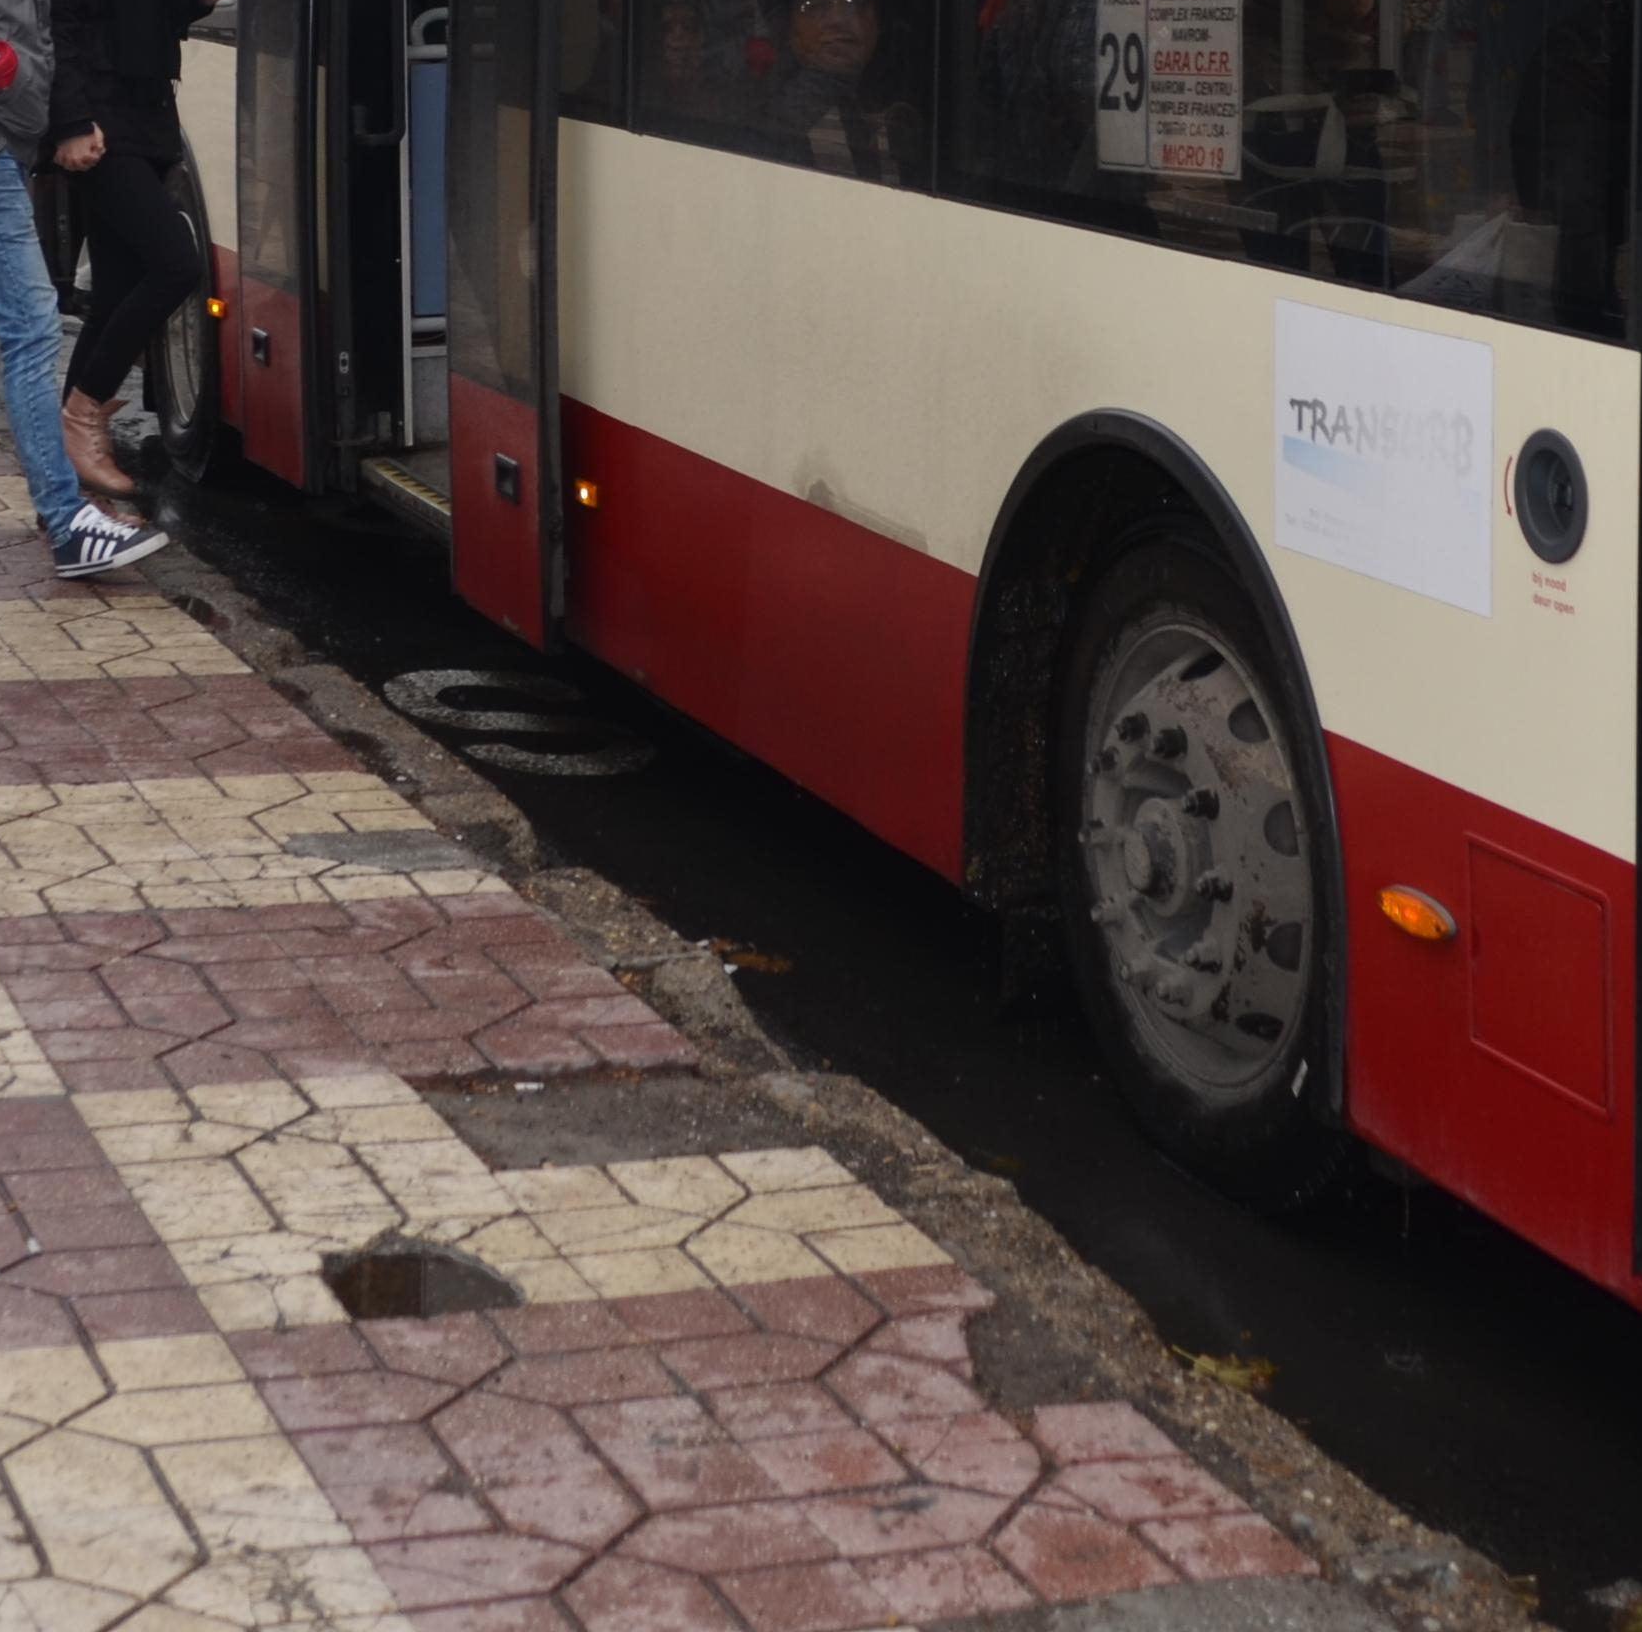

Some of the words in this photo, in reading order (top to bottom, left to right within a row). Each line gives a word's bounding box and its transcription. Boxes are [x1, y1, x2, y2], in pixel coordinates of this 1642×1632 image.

[1149, 7, 1190, 22] COMPLEX
[1154, 51, 1192, 72] GARA
[1194, 51, 1232, 73] C.F.R.
[1098, 32, 1145, 113] 29
[1194, 81, 1233, 96] CENTRU
[1150, 100, 1190, 115] COMPLEX
[1161, 144, 1205, 167] MICRO
[1209, 147, 1224, 169] 19
